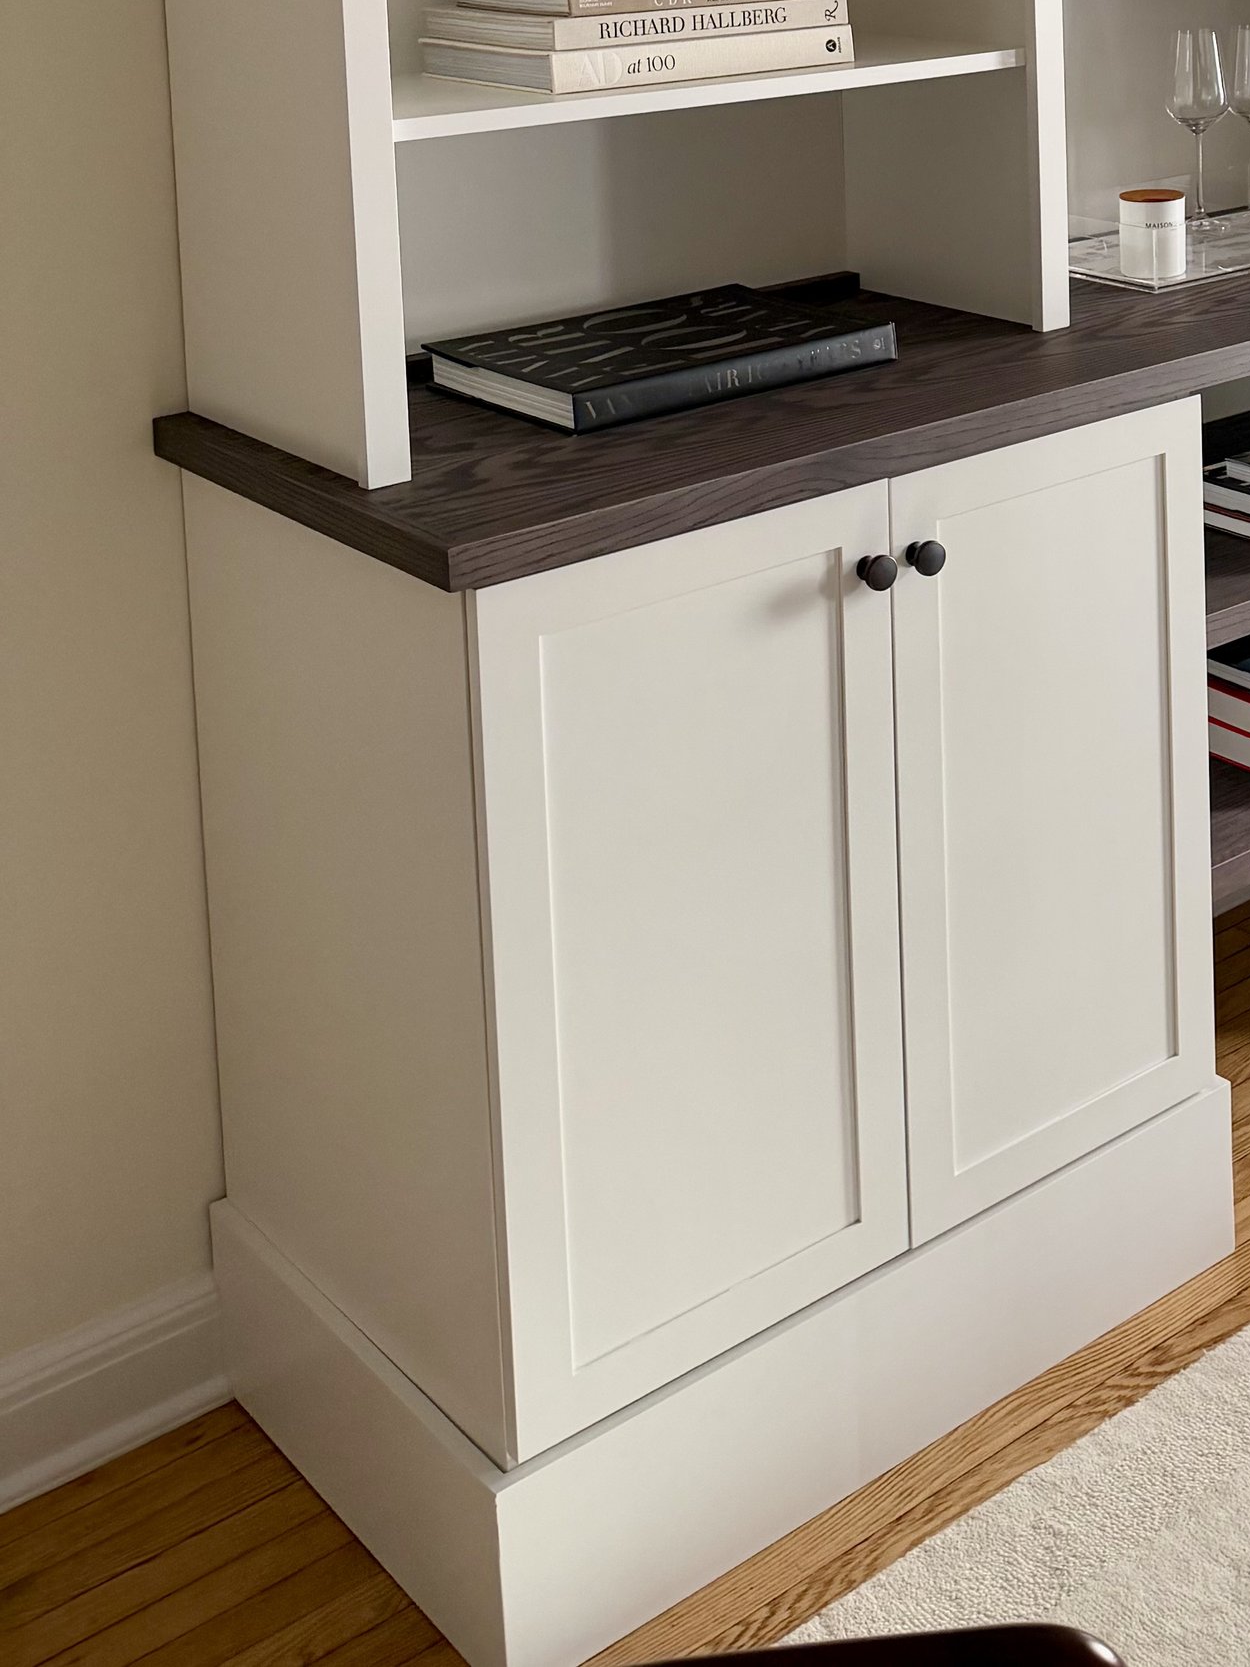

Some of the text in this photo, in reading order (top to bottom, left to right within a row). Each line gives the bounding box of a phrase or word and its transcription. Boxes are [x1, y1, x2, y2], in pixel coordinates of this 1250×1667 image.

[598, 7, 787, 41] RICHARD HALLBERG
[578, 51, 676, 87] AD at 100
